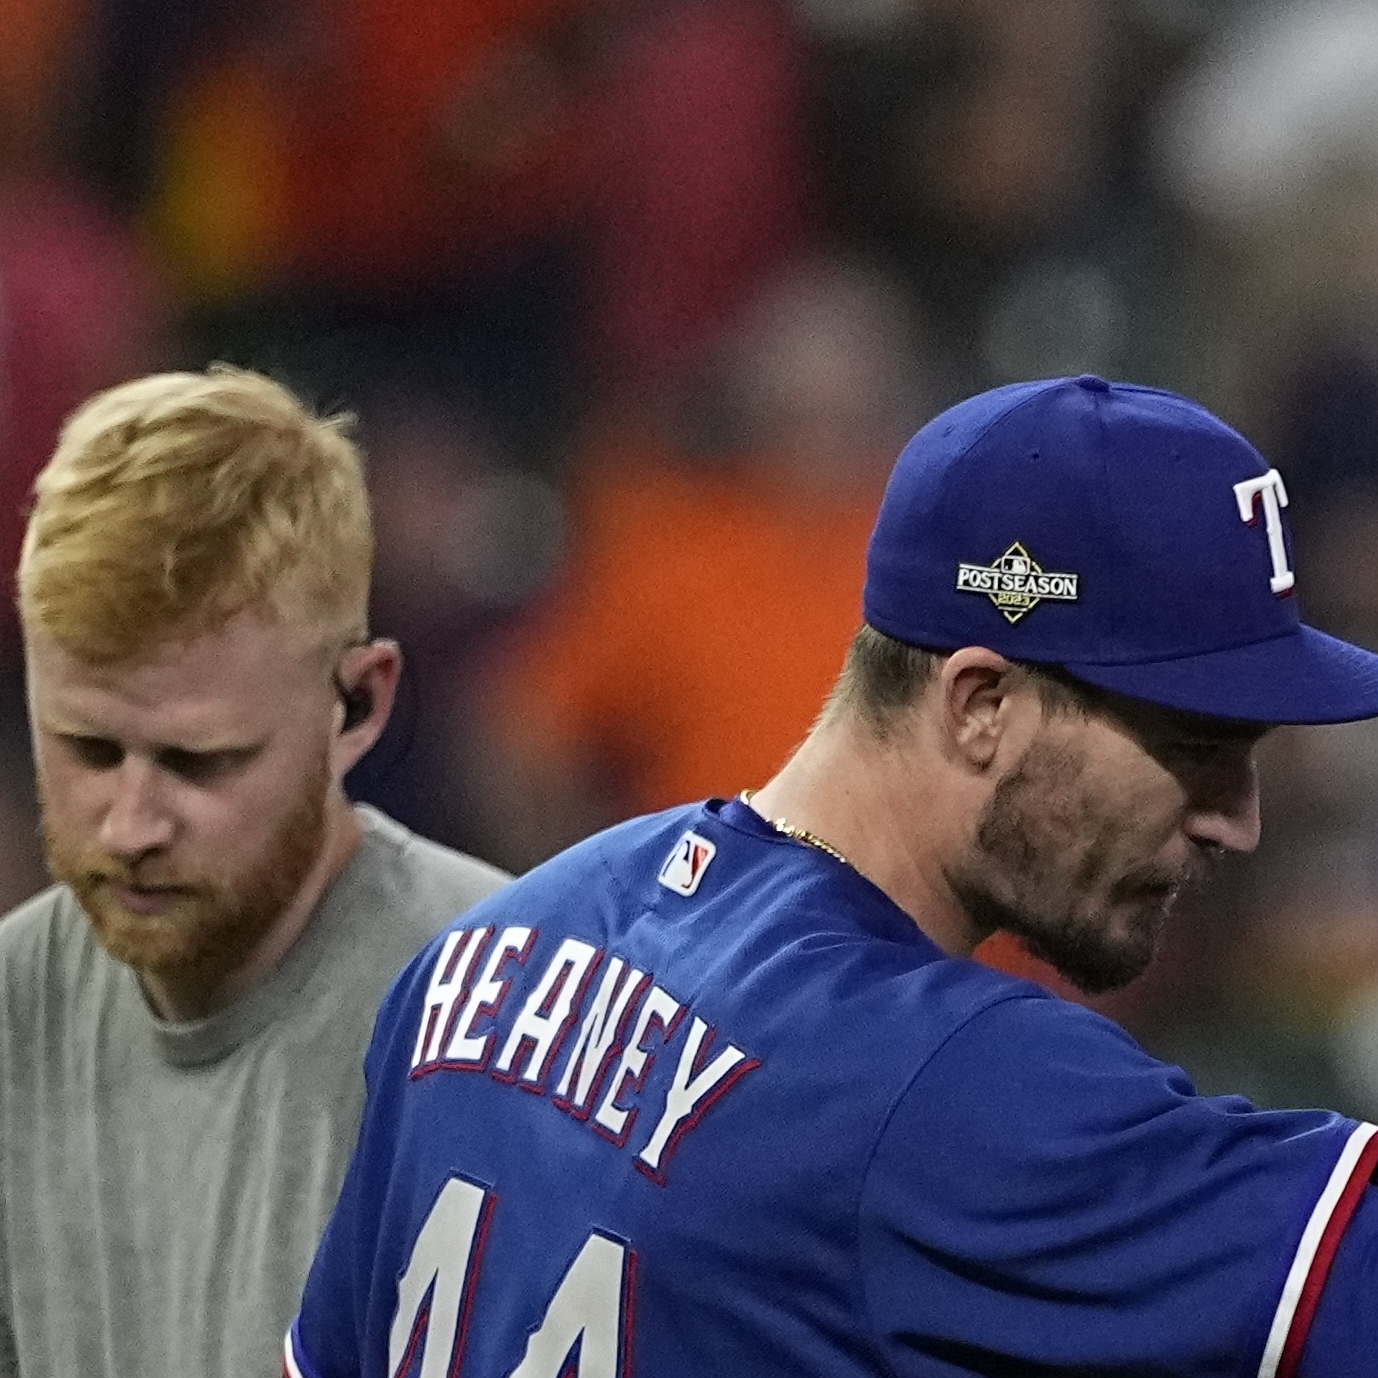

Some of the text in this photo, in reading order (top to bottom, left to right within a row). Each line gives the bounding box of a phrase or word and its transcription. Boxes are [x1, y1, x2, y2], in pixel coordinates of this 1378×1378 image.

[957, 568, 1078, 596] POSTSEASON
[1233, 469, 1296, 596] T
[409, 926, 760, 1184] HEANEY
